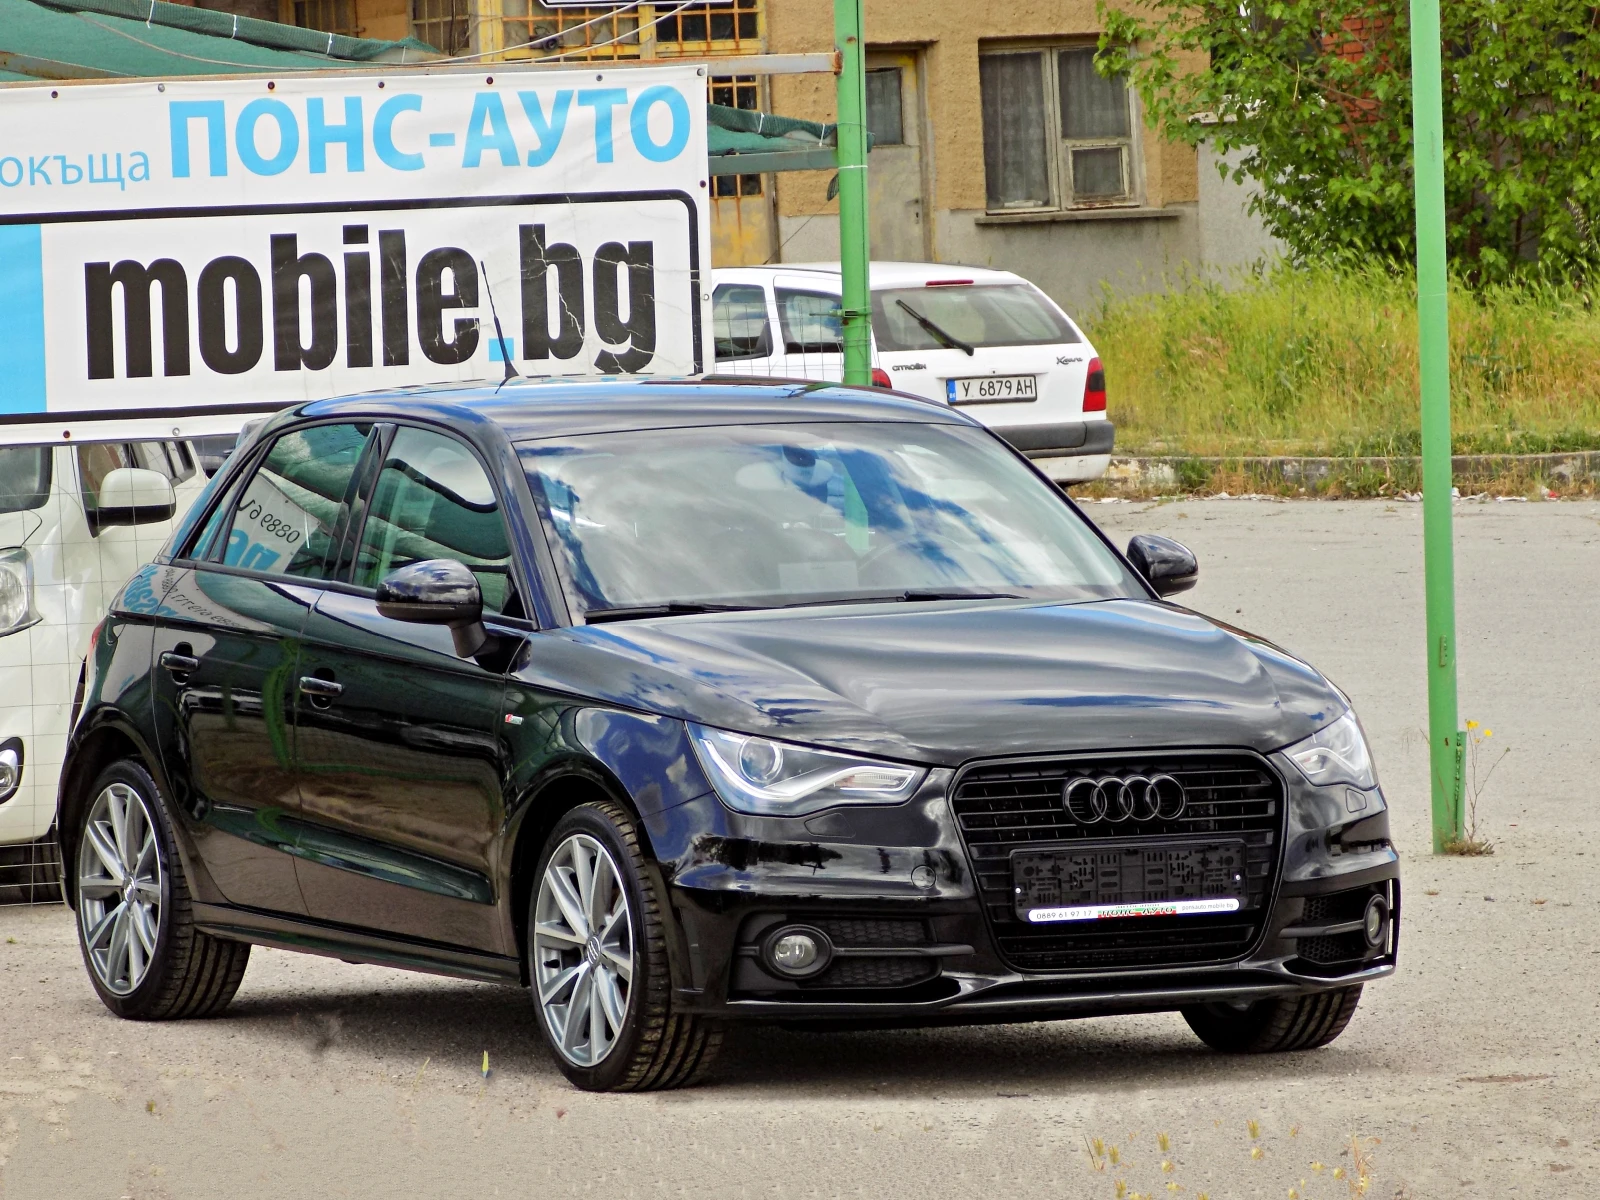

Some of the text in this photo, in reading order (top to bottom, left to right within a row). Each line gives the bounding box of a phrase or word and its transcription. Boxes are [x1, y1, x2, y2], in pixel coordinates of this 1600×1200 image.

[0, 84, 692, 191] окъща ПОНС-АУТО
[83, 223, 656, 380] mobile.bg
[979, 380, 1012, 397] 6879
[1036, 912, 1056, 920] 0889
